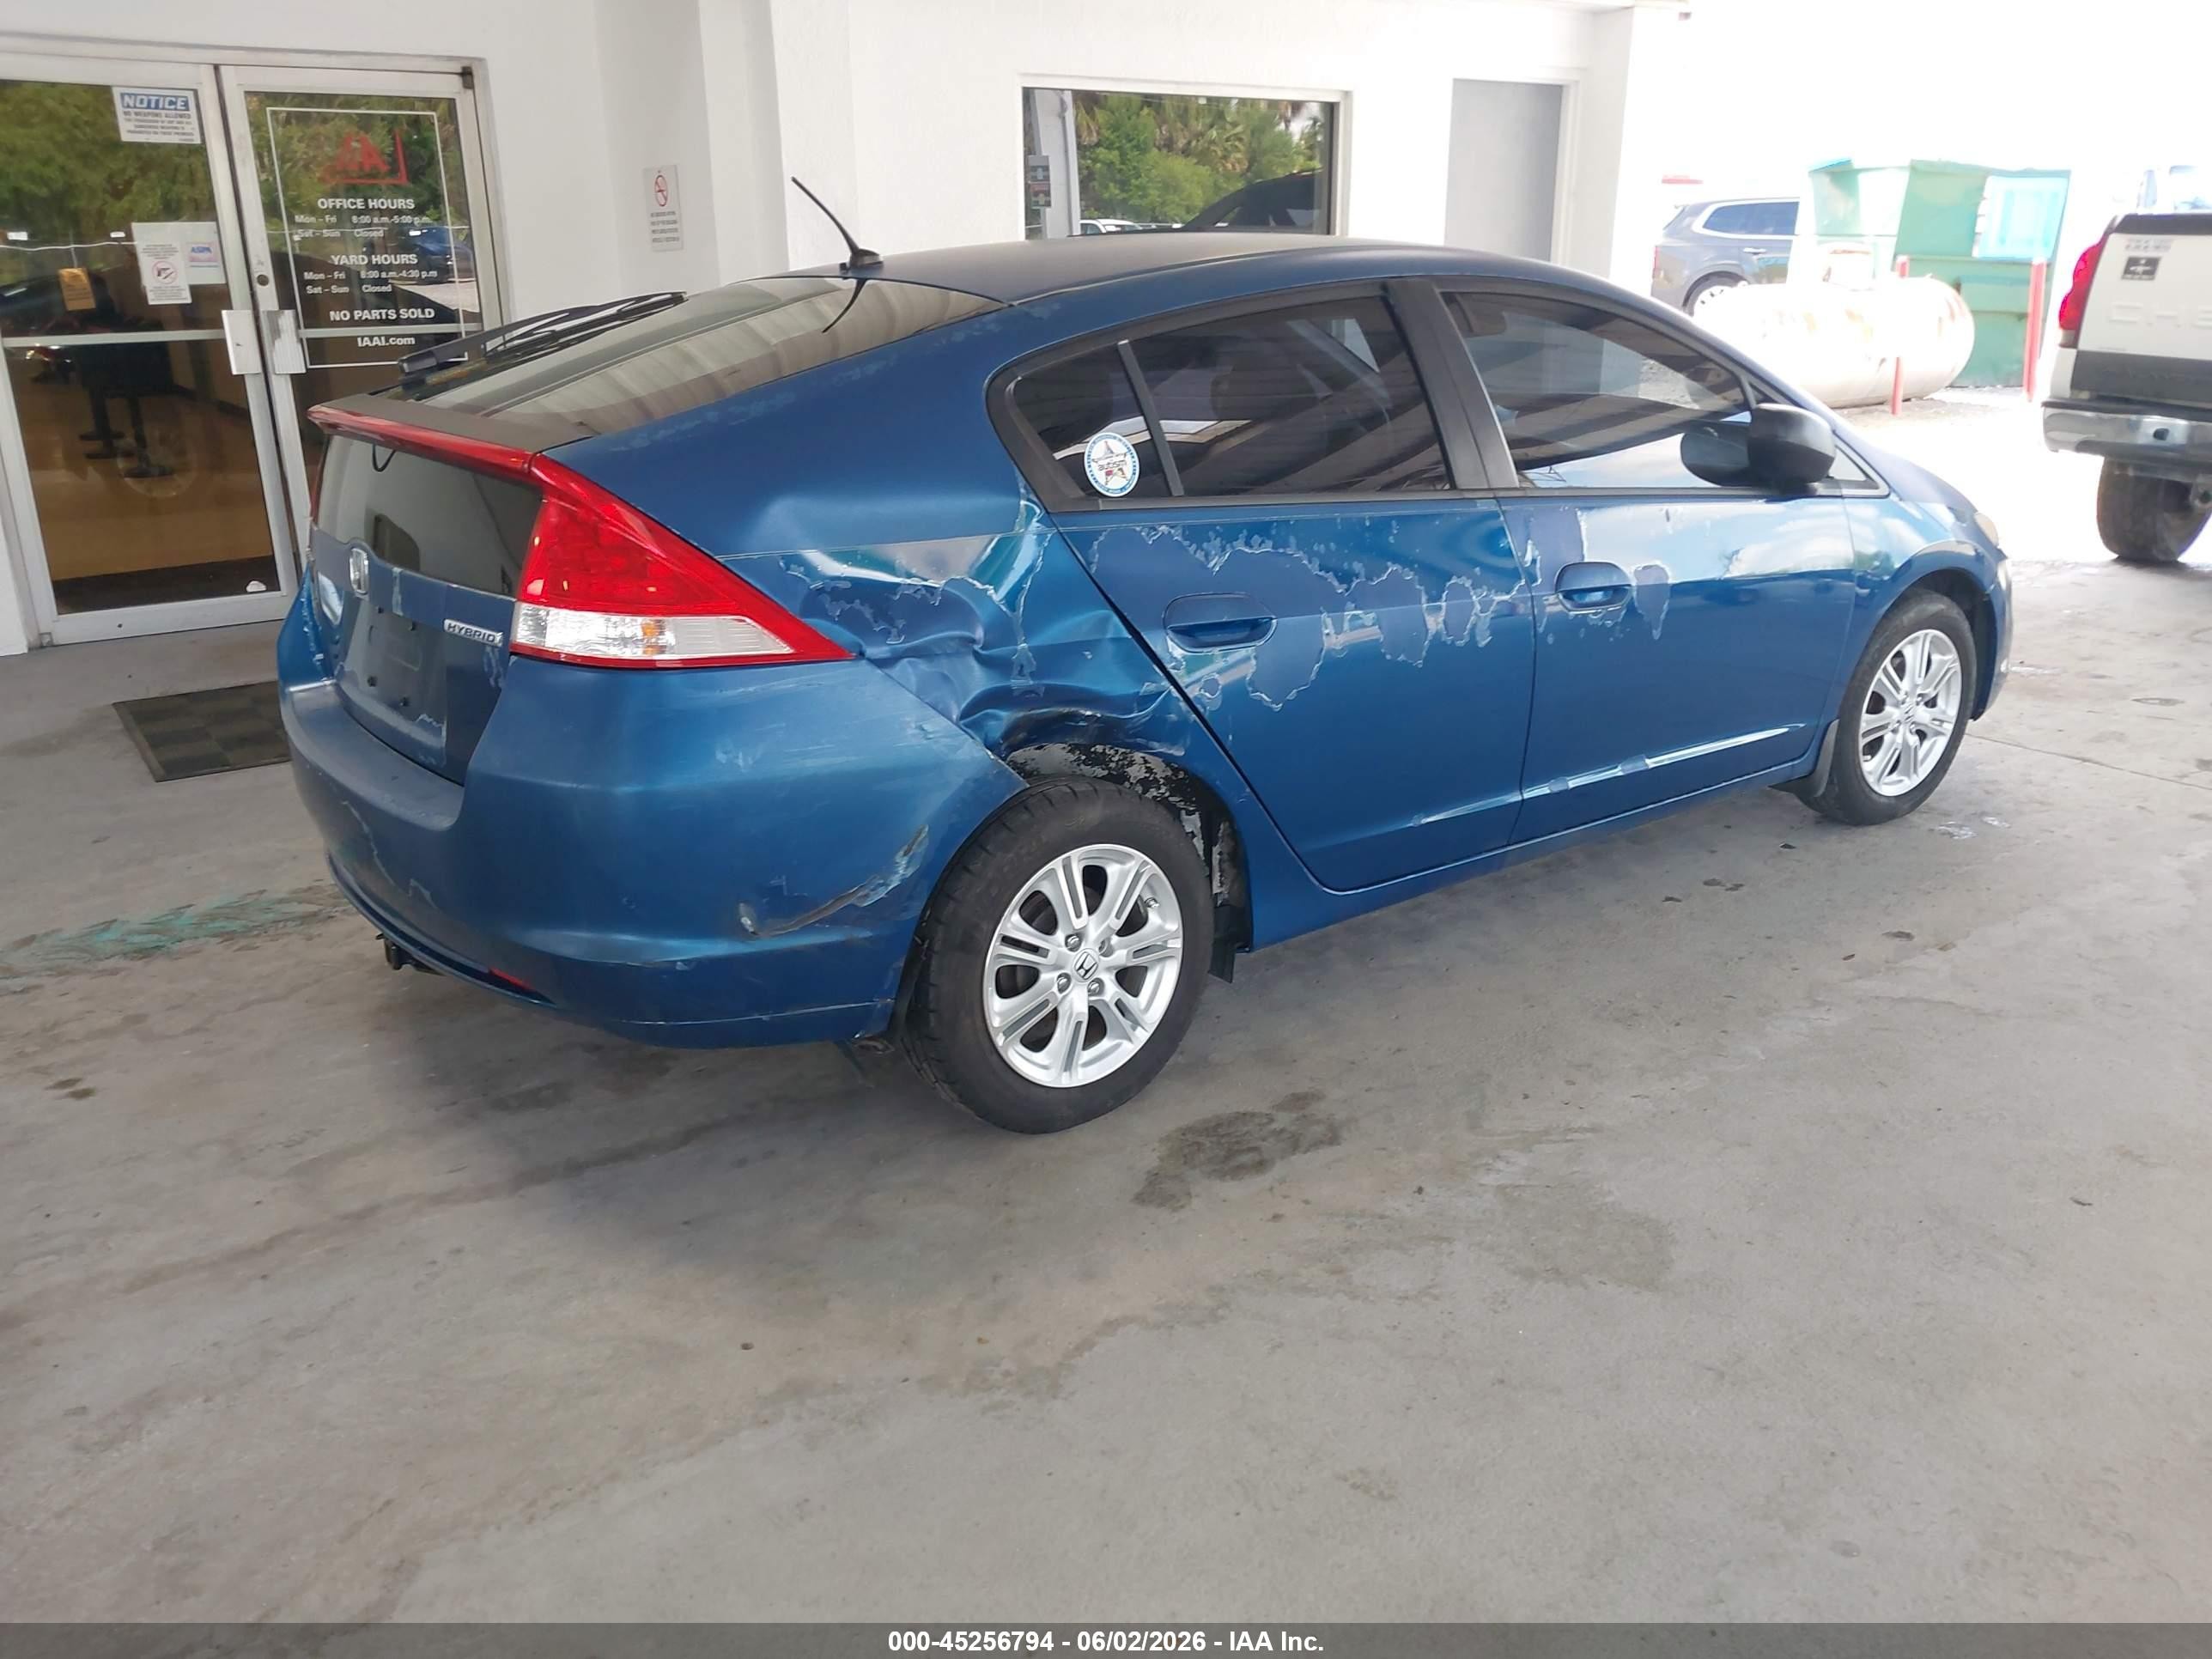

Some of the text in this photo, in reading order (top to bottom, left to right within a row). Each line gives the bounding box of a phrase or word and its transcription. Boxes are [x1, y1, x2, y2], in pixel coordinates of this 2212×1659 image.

[123, 94, 187, 109] NOTICE
[317, 198, 416, 210] OFFICE HOURS
[295, 215, 316, 223] Mon
[325, 215, 337, 223] Fri
[354, 229, 385, 238] Closed
[331, 254, 418, 265] YARD HOURS
[304, 271, 325, 280] Mon
[362, 284, 392, 293] Closed
[330, 308, 435, 321] NO PARTS SOLD
[357, 336, 416, 347] IAAI.com
[447, 623, 495, 642] HYBRID
